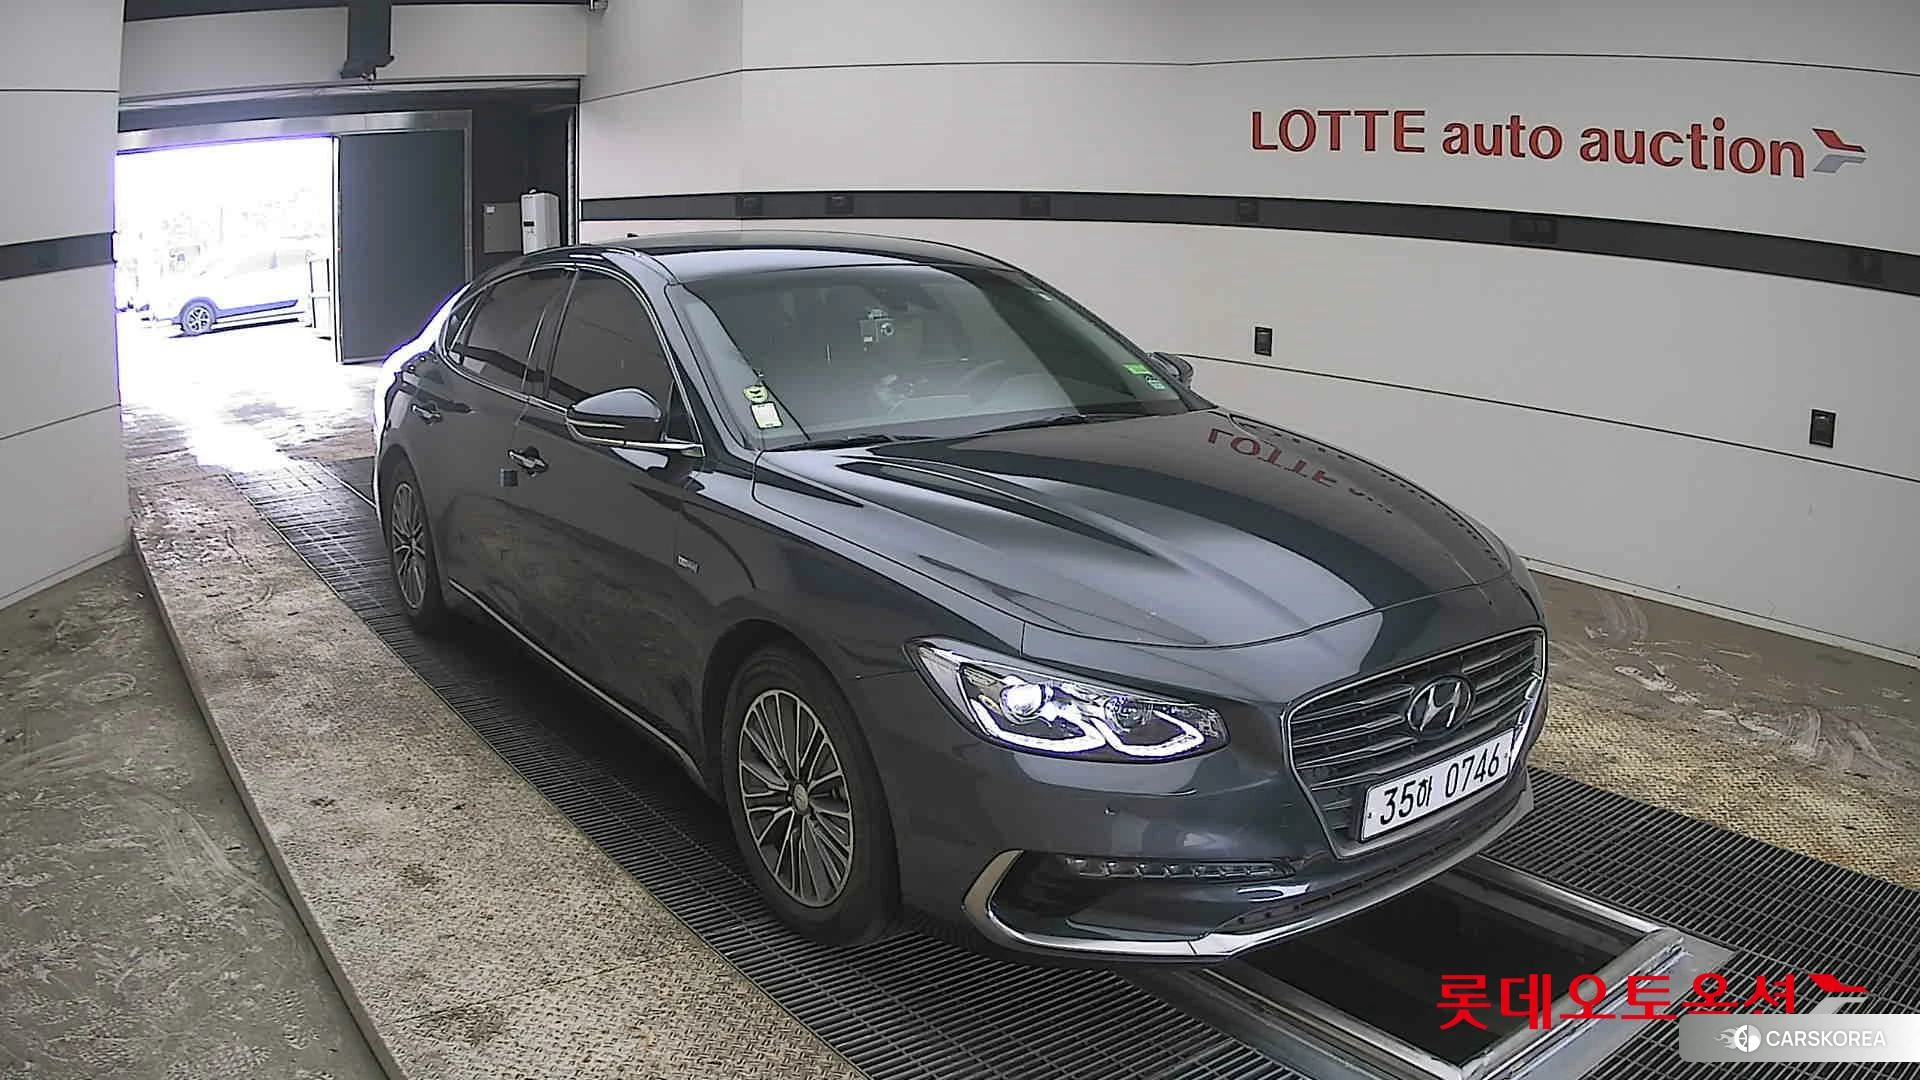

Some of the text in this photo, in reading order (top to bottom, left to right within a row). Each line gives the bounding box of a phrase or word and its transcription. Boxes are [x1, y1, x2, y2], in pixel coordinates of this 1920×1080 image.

[1251, 109, 1805, 178] LOTTE auto auction
[1380, 743, 1500, 825] 35하 0746
